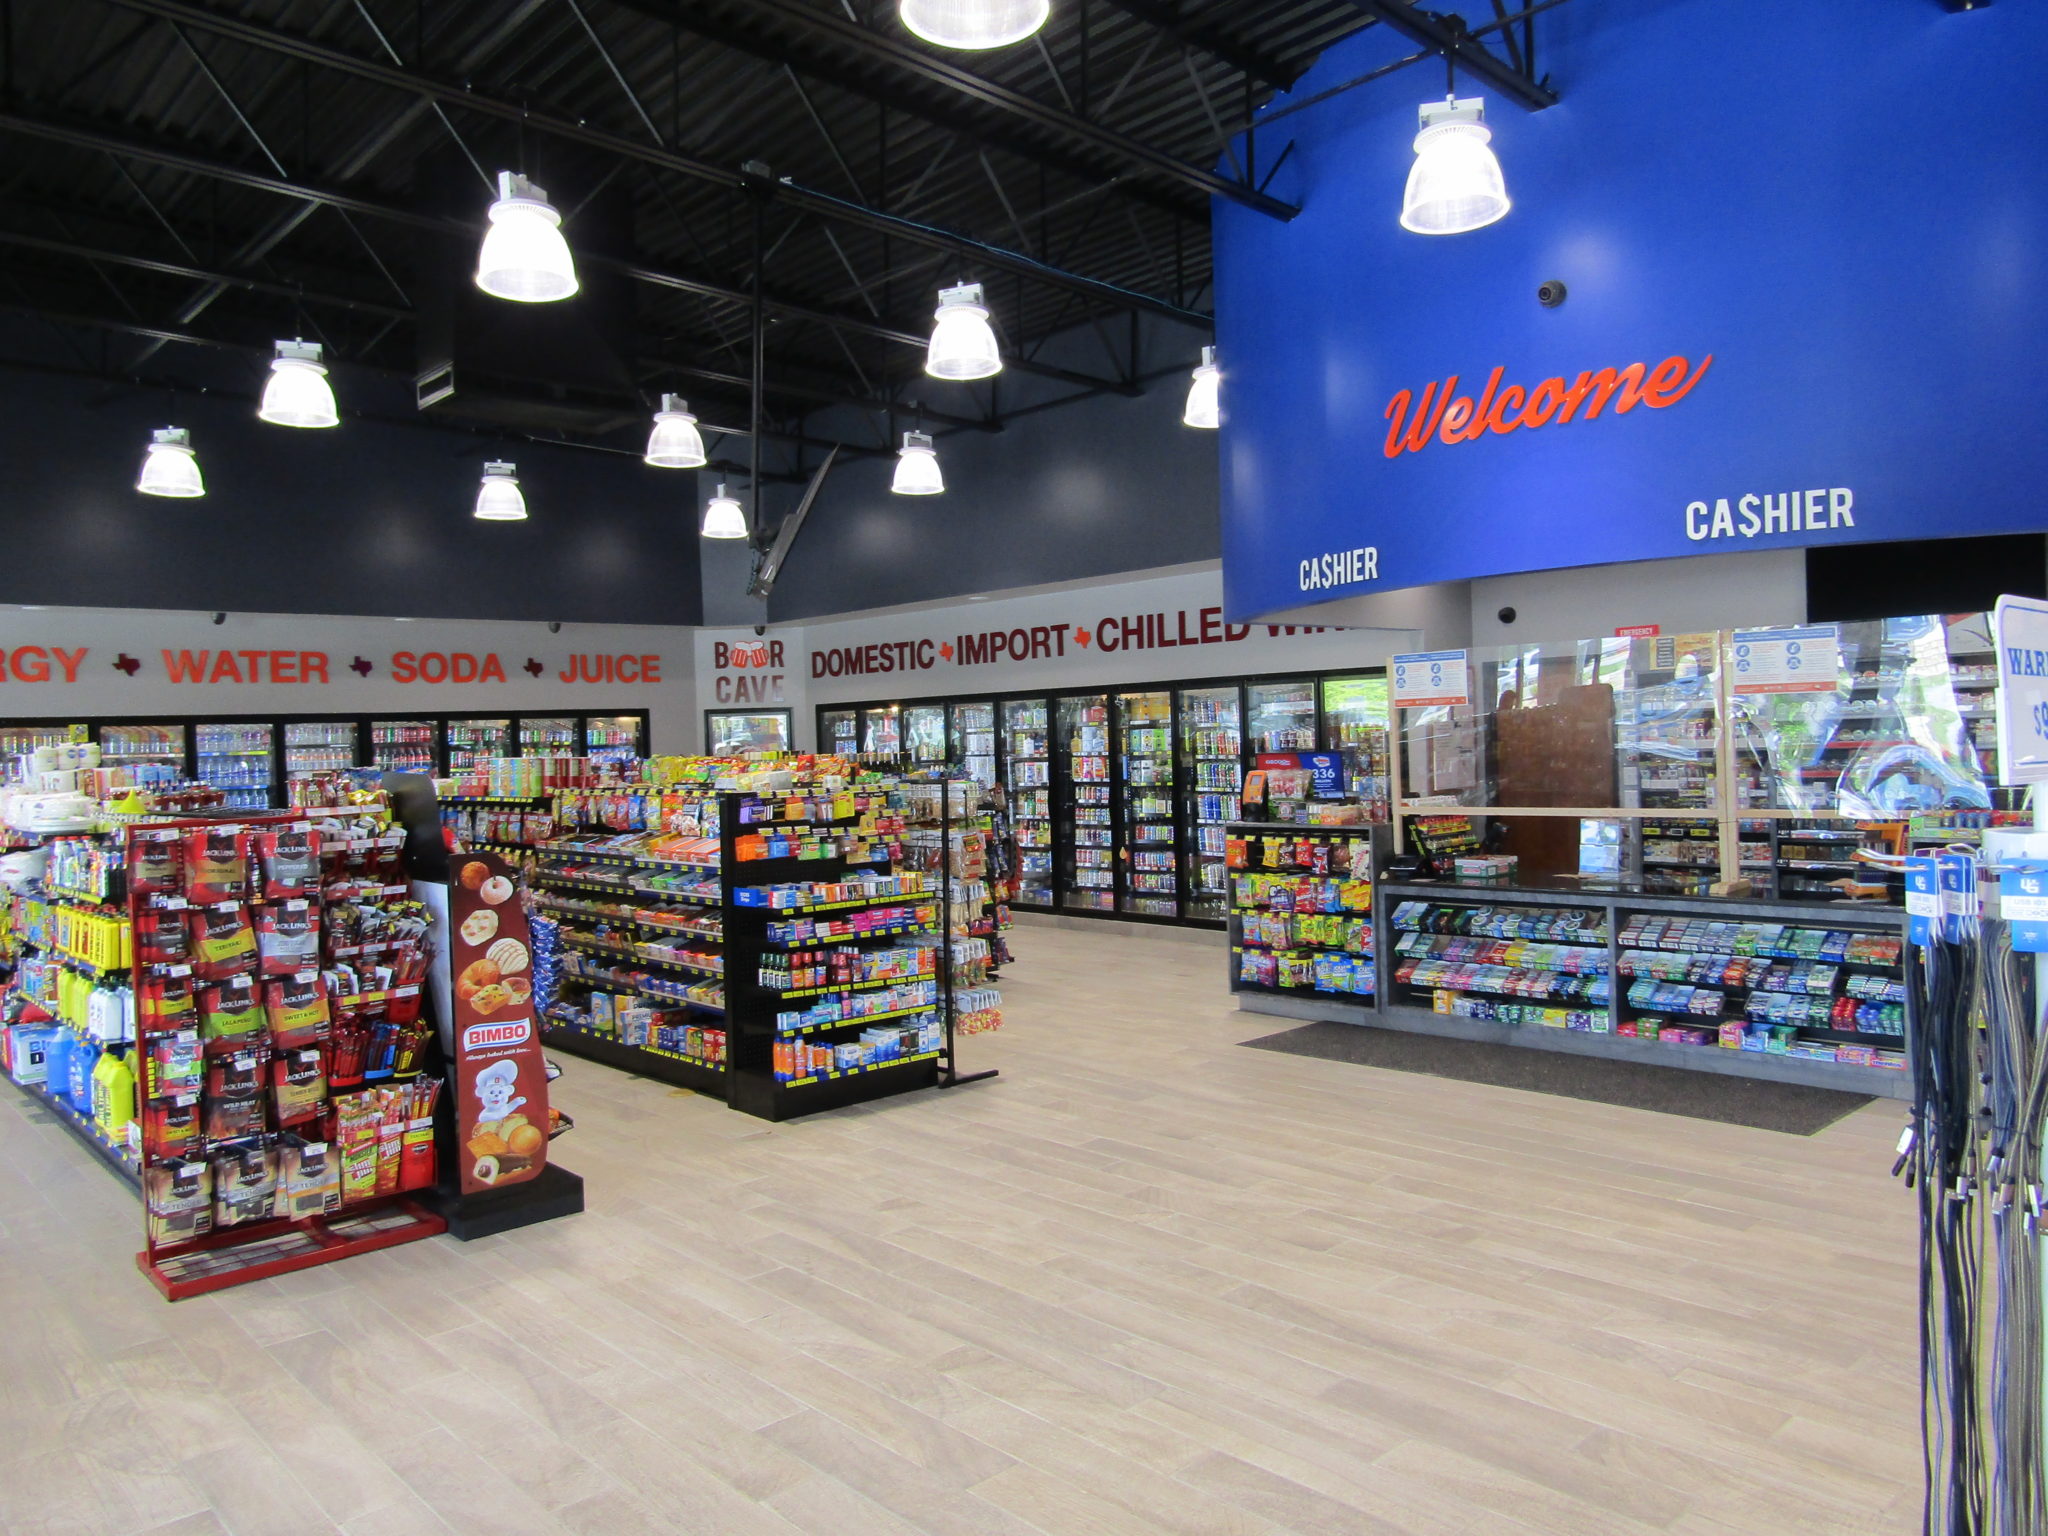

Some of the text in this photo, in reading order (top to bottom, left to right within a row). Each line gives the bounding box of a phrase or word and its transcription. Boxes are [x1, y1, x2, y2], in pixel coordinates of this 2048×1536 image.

[1384, 354, 1713, 458] Welcome
[811, 639, 935, 679] DOMESTIC
[957, 623, 1070, 666] IMPORT
[0, 645, 89, 683] GY
[161, 648, 329, 684] WATER
[391, 651, 507, 684] SODA
[559, 654, 662, 684] JUICE
[2007, 647, 2048, 677] WAR
[715, 674, 784, 703] CAVE
[1311, 768, 1336, 779] 336
[469, 1024, 526, 1044] BIMBO
